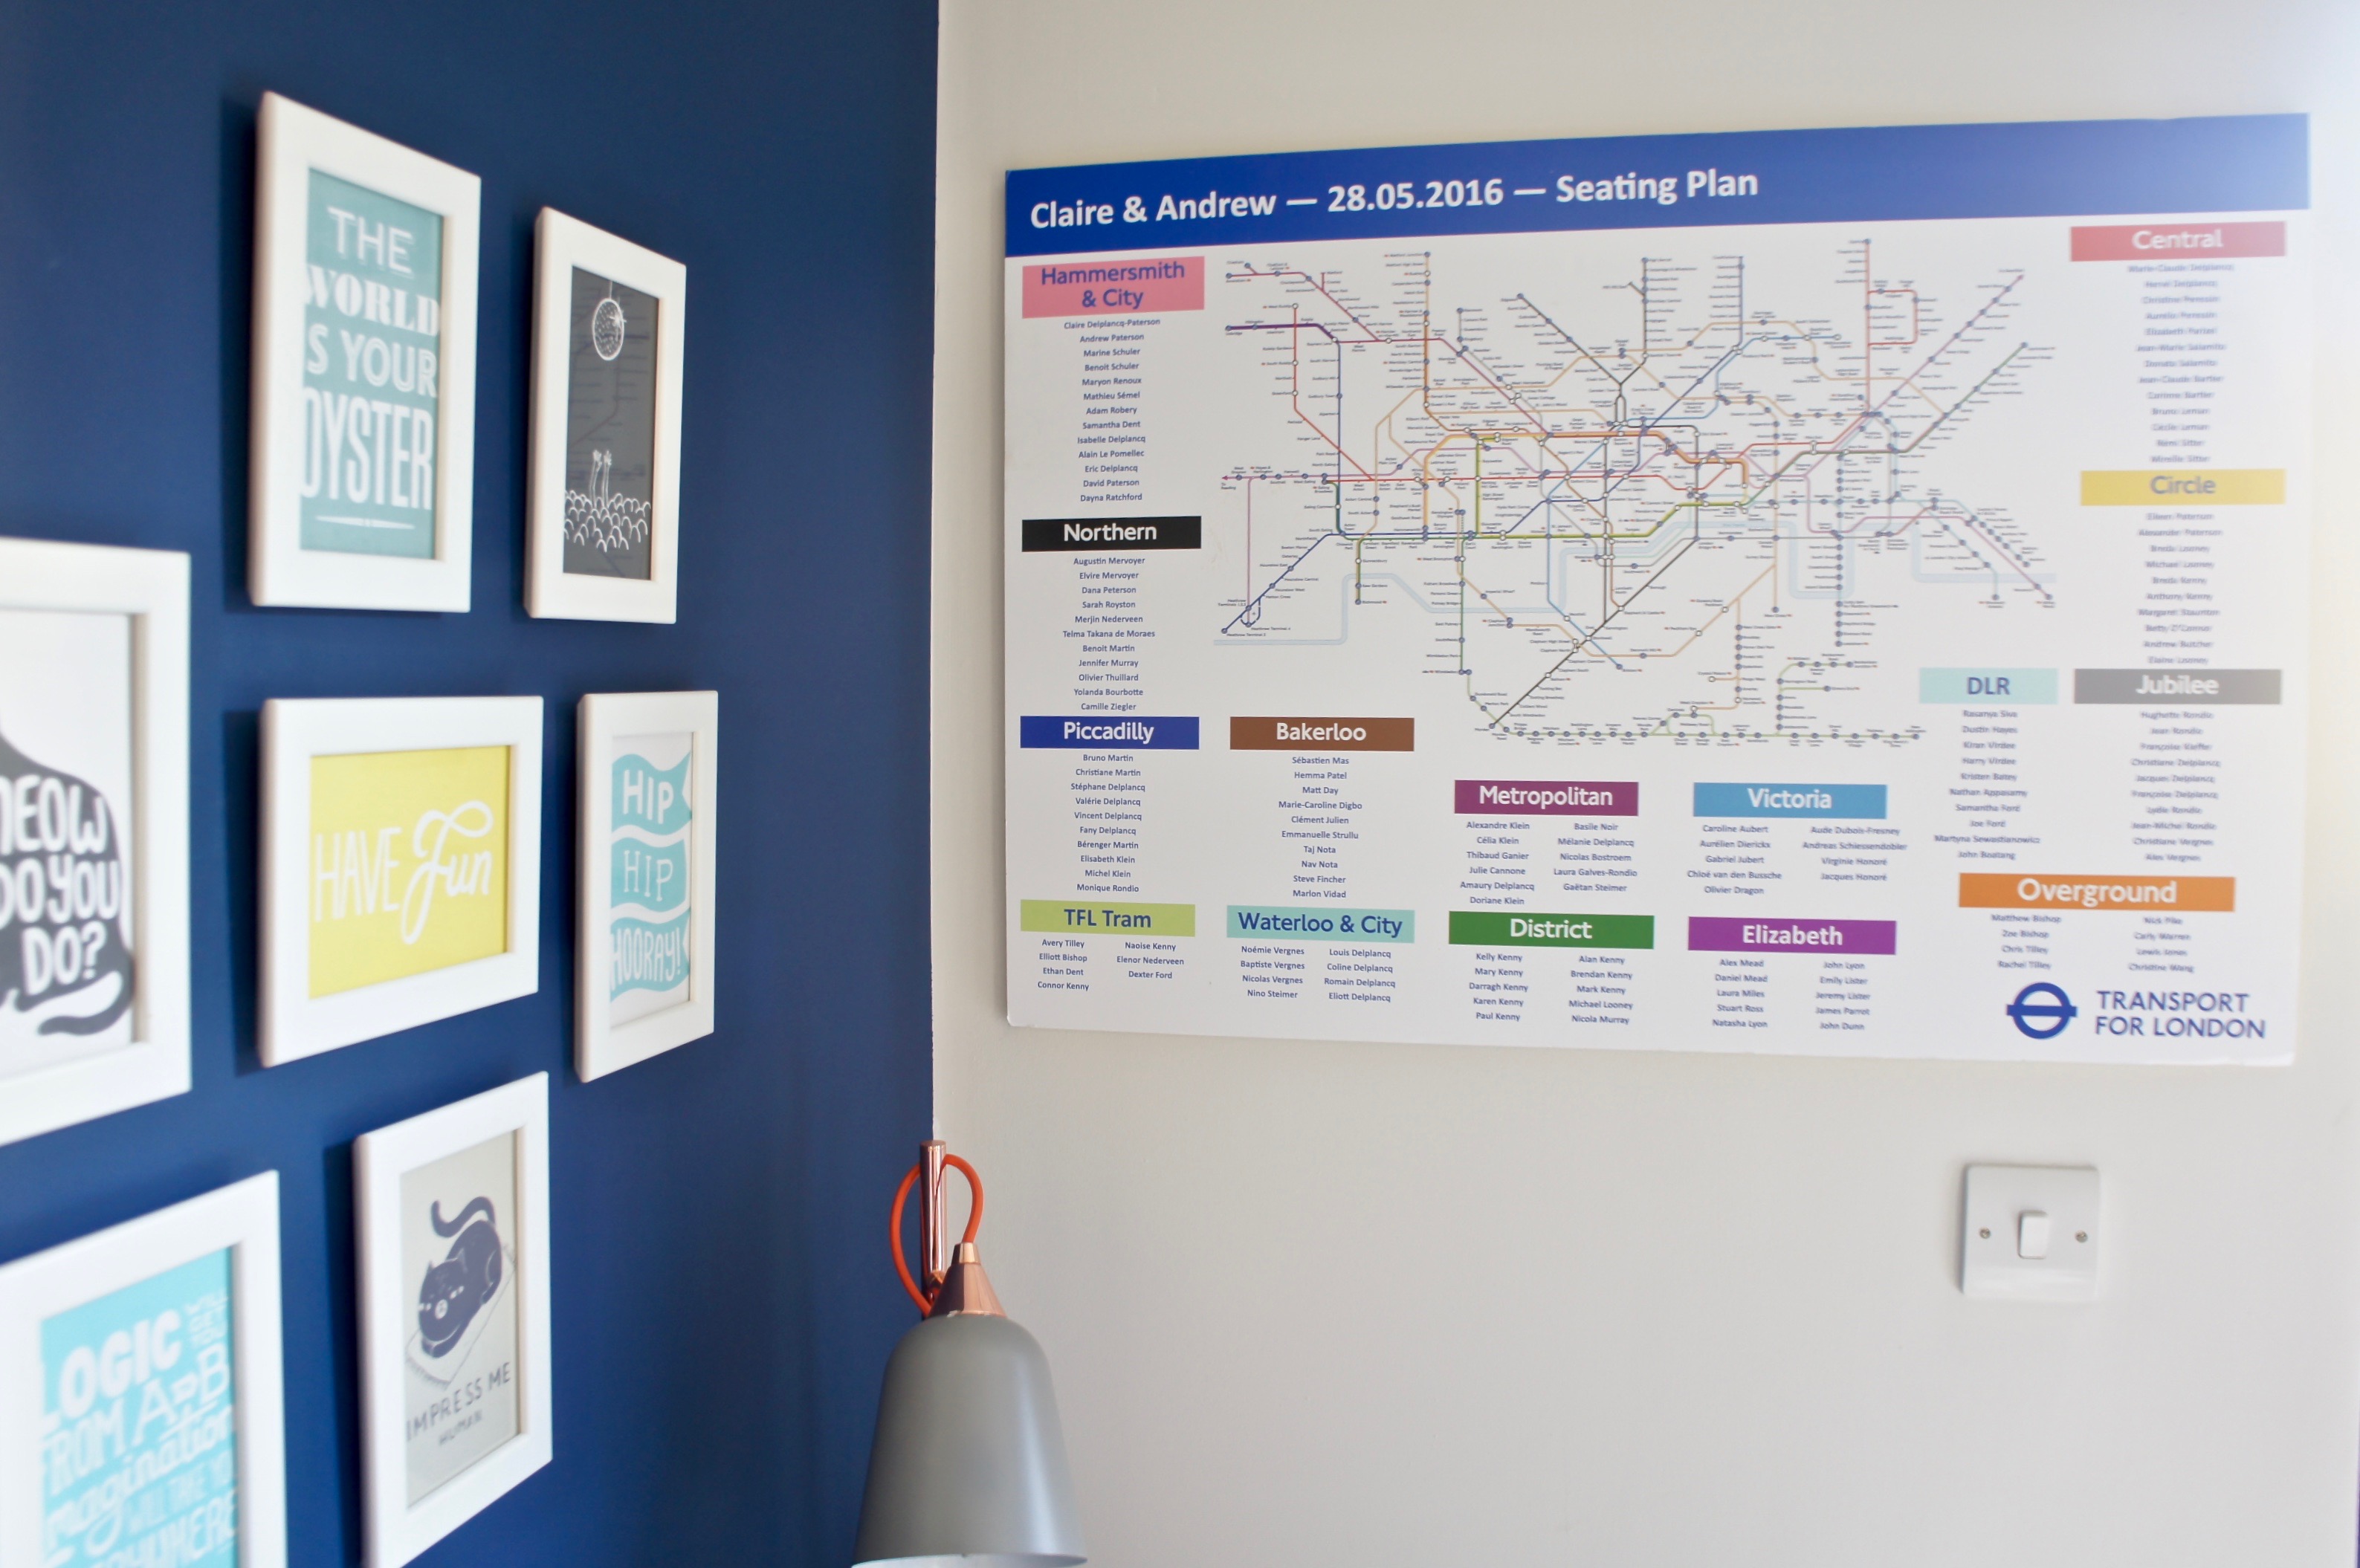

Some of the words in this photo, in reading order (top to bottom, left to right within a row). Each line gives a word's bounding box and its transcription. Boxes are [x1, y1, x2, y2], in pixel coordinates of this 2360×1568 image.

[1031, 200, 1113, 228] Claire
[1122, 195, 1147, 223] &
[1155, 190, 1277, 221] Andrew
[1328, 178, 1504, 212] 28.05.2016
[1556, 172, 1678, 205] Seating
[1687, 169, 1759, 198] Plan
[327, 205, 414, 277] THE
[2132, 229, 2223, 250] Central
[1041, 261, 1185, 285] Hammersmith
[1082, 290, 1096, 308] &
[1103, 288, 1144, 309] City
[340, 329, 437, 398] YOUR
[2150, 475, 2217, 494] Circle
[1064, 522, 1157, 542] Northern
[1073, 557, 1106, 566] Augustin
[1109, 557, 1145, 566] Mervoyer
[1105, 601, 1135, 609] Royston
[1111, 659, 1138, 667] Murray
[1967, 677, 2011, 696] DLR
[2136, 674, 2220, 694] Jubilee
[1111, 703, 1136, 711] Ziegler
[1064, 721, 1154, 745] Piccadilly
[1276, 722, 1367, 741] Bakerloo
[623, 769, 673, 824] HIP
[1108, 783, 1145, 792] Delplancq
[1324, 787, 1338, 795] Day
[1479, 785, 1613, 809] Metropolitan
[1104, 798, 1140, 806] Delplancq
[1339, 802, 1362, 810] Digbo
[1747, 788, 1832, 809] Victoria
[1105, 812, 1142, 821] Delplancq
[1081, 855, 1114, 863] Elisabeth
[1303, 846, 1314, 855] Taj
[316, 826, 402, 923] HAVE
[401, 800, 494, 946] Fun
[624, 850, 673, 901] HIP
[48, 854, 119, 924] YOU
[1077, 884, 1110, 892] Monique
[2017, 878, 2177, 907] Overground
[1064, 909, 1096, 927] TFL
[1102, 910, 1151, 928] Tram
[1238, 911, 1333, 933] Waterloo
[1339, 916, 1354, 933] &
[1361, 916, 1403, 939] City
[1510, 918, 1593, 939] District
[1042, 939, 1063, 947] Avery
[1065, 940, 1084, 948] Tilley
[1742, 925, 1843, 946] Elizabeth
[22, 921, 107, 996] DO?
[1063, 954, 1087, 963] Bishop
[1273, 947, 1304, 956] Vergnes
[1352, 950, 1391, 959] Delplancq
[1067, 982, 1089, 991] Kenny
[1272, 976, 1302, 985] Vergnes
[1357, 979, 1395, 988] Delplancq
[2097, 990, 2249, 1012] TRANSPORT
[2095, 1015, 2144, 1037] FOR
[2154, 1017, 2266, 1039] LONDON
[42, 1309, 181, 1439] OGIC
[488, 1361, 511, 1391] ME
